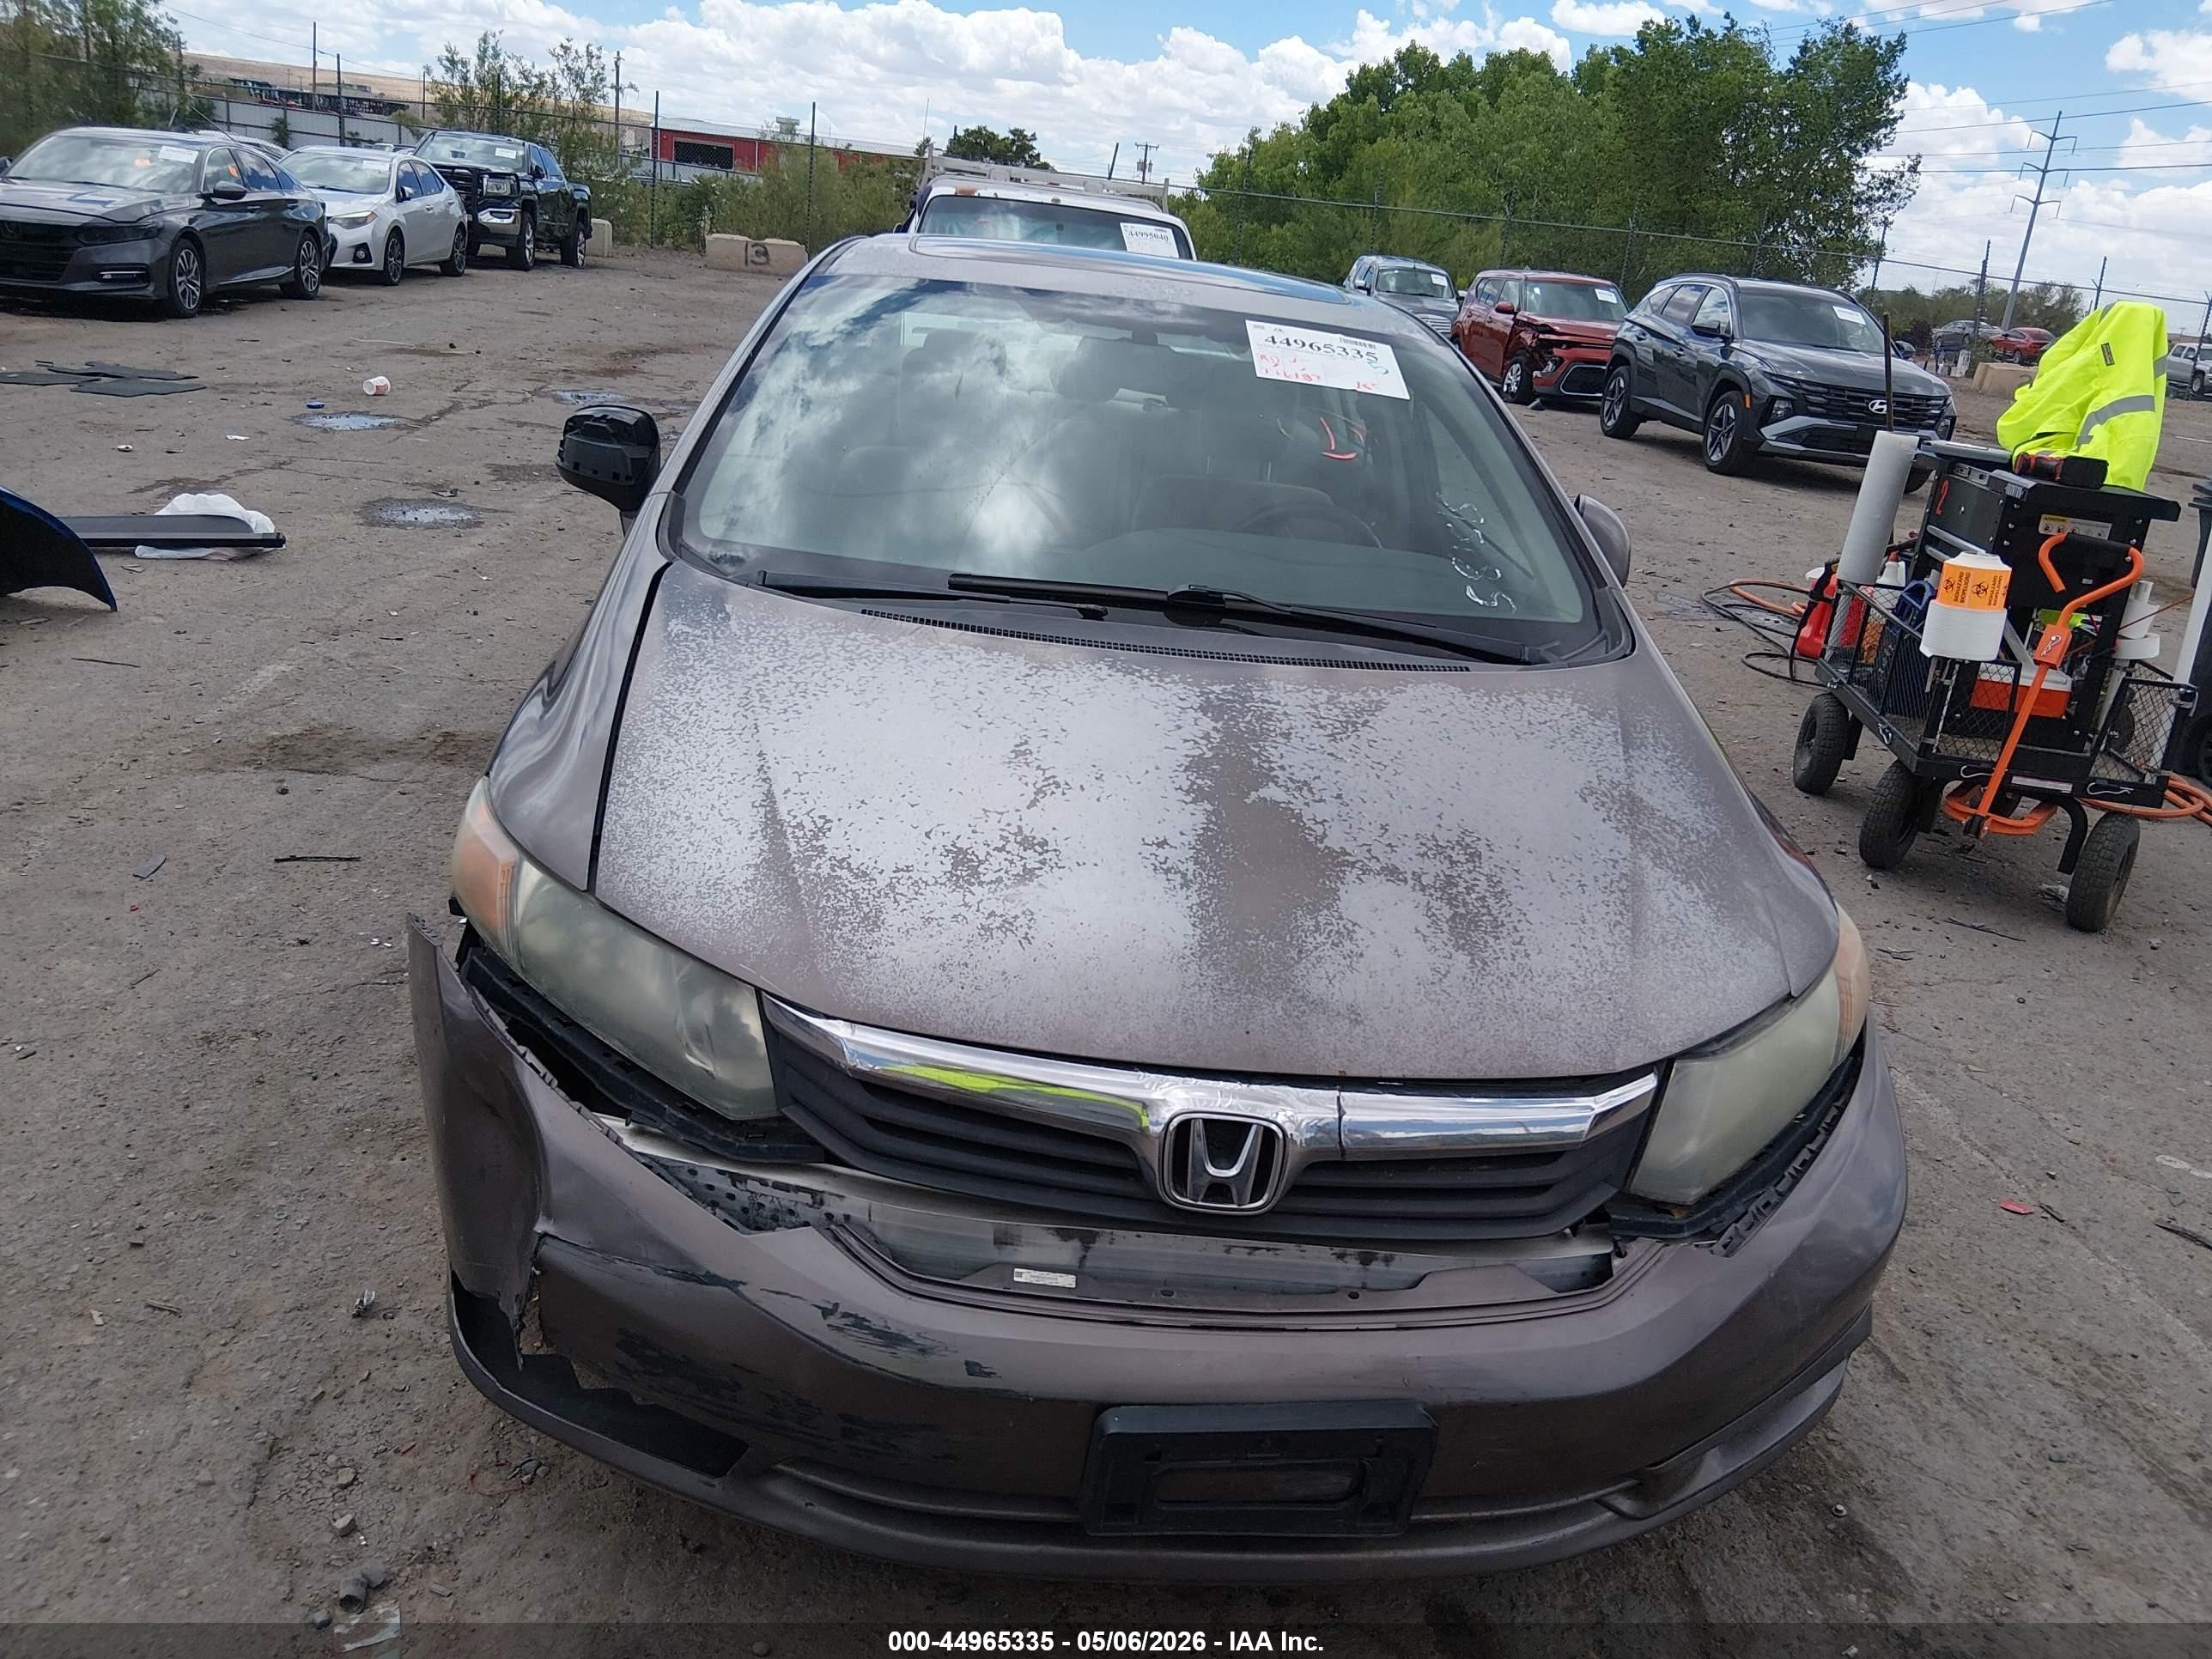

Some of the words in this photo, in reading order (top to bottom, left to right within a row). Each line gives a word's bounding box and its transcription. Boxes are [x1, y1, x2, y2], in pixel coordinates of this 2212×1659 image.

[744, 240, 769, 265] 13
[1265, 335, 1379, 362] 44965335
[1954, 571, 1964, 602] BIOHAZARD
[1960, 572, 1971, 603] BIOPELIGRO
[1987, 575, 1997, 605] BIOHAZARD
